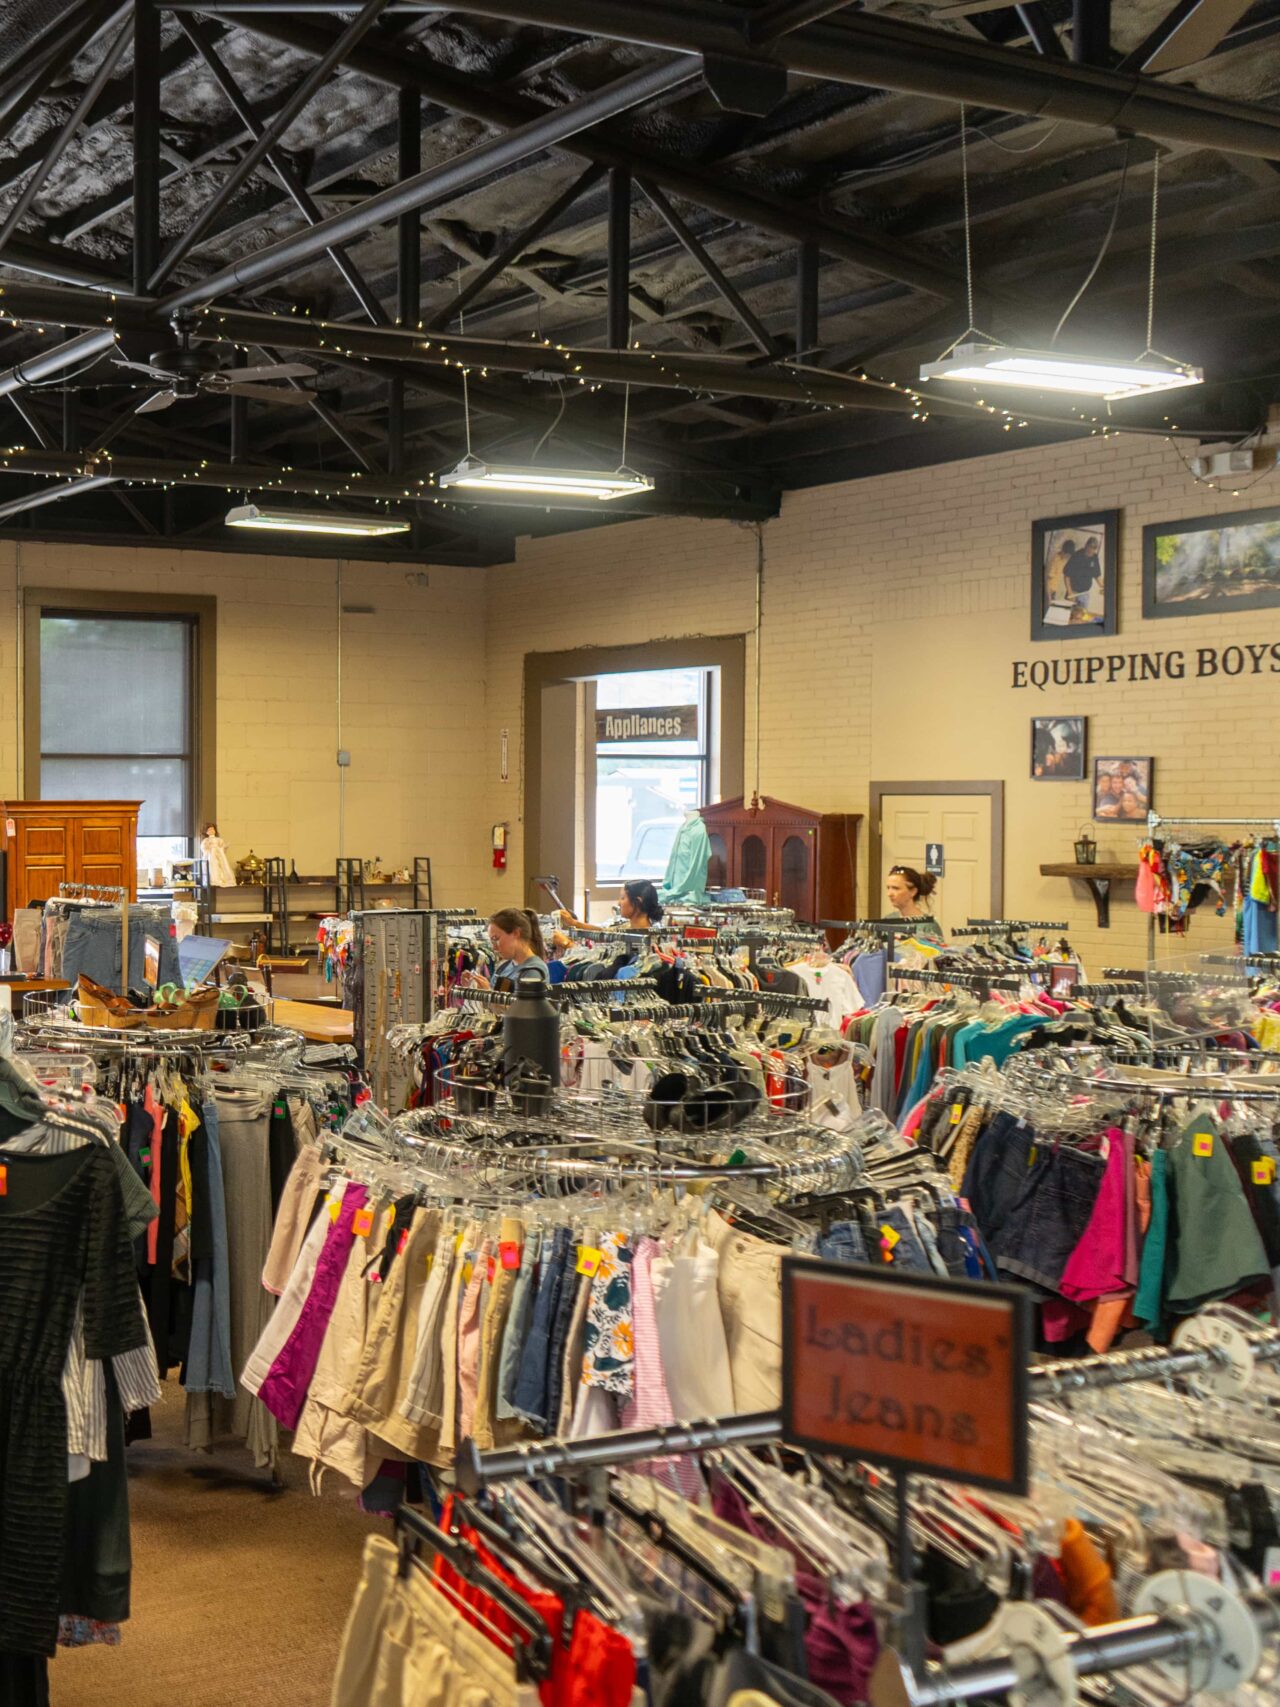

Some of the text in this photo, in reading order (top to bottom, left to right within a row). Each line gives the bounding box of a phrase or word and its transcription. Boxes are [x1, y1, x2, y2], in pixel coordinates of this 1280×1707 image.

[1011, 650, 1185, 691] EQUIPPING
[605, 714, 682, 740] Appliances
[822, 1374, 980, 1447] Jeans
